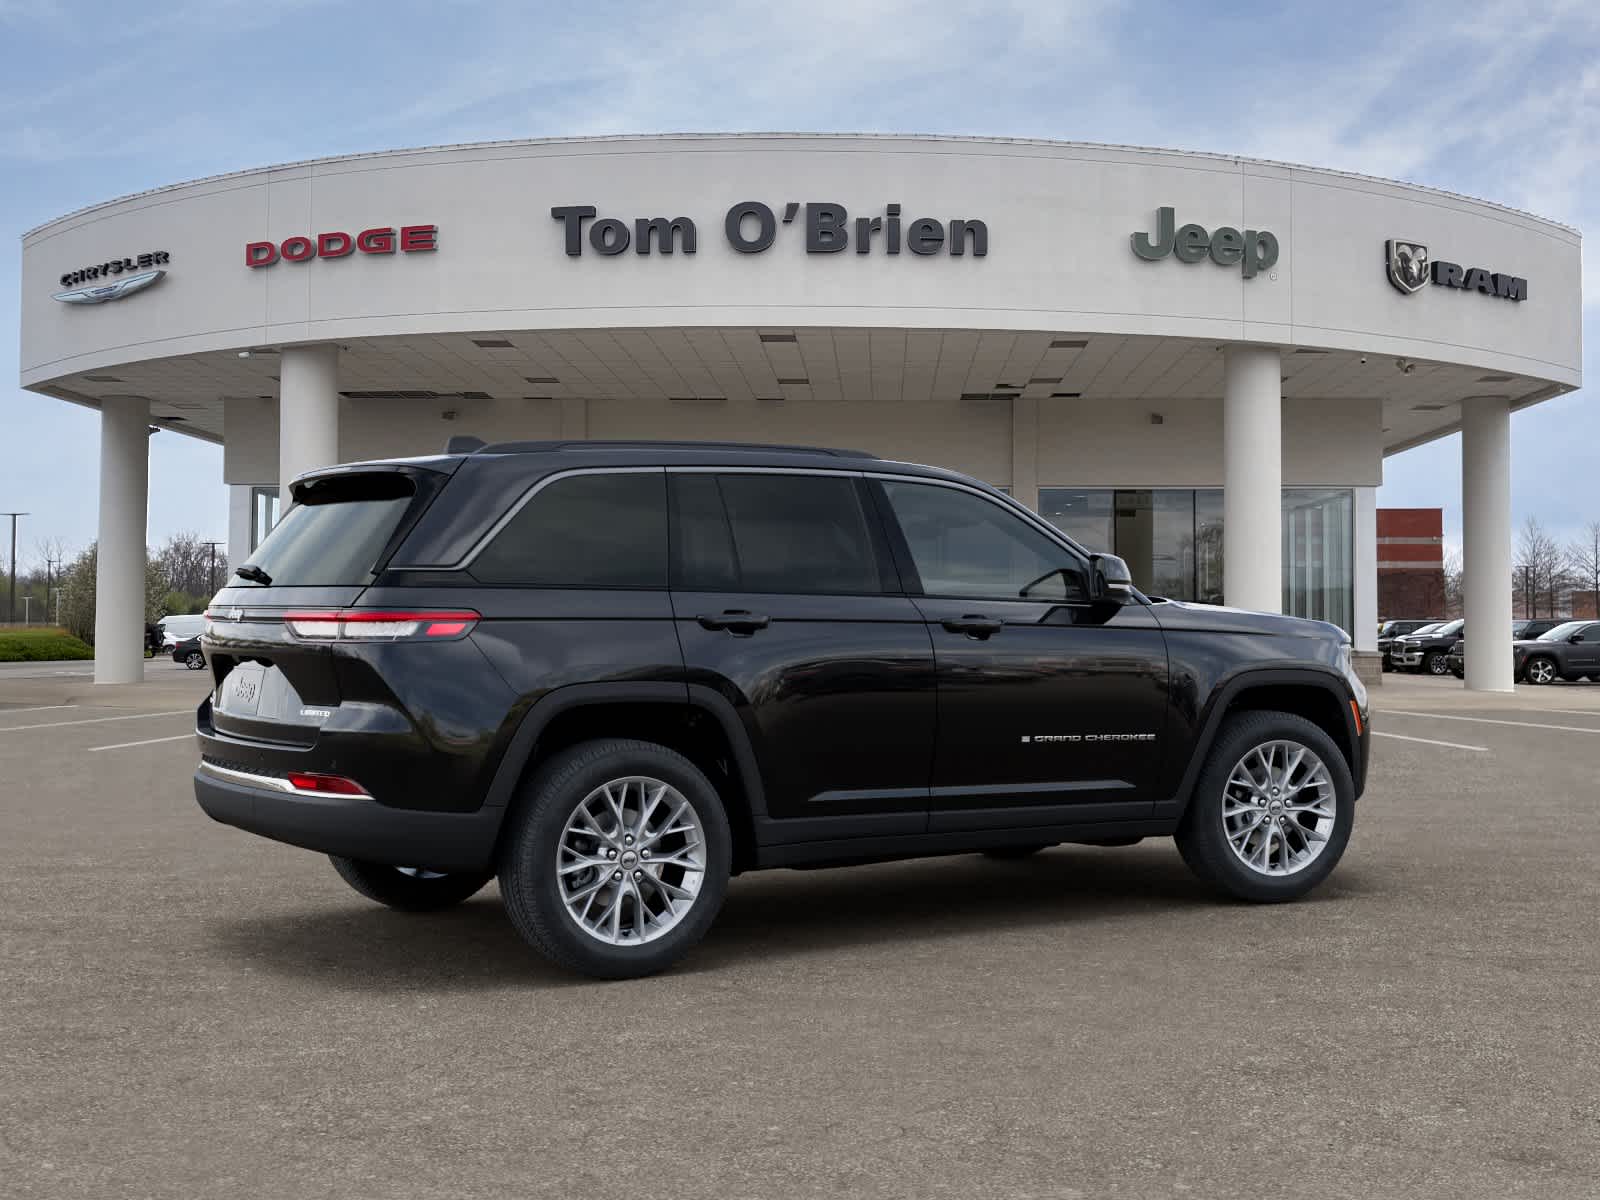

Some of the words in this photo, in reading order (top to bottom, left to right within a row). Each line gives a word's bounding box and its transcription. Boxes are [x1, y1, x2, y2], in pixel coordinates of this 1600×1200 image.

[245, 225, 438, 269] DODGE
[551, 205, 696, 257] Tom
[724, 201, 988, 257] O'Brien
[1130, 206, 1280, 279] Jeep
[60, 250, 170, 286] CHRYSLER
[1430, 261, 1528, 301] RAM
[1034, 735, 1082, 743] GRAND
[1085, 734, 1156, 742] CHEROKEE
